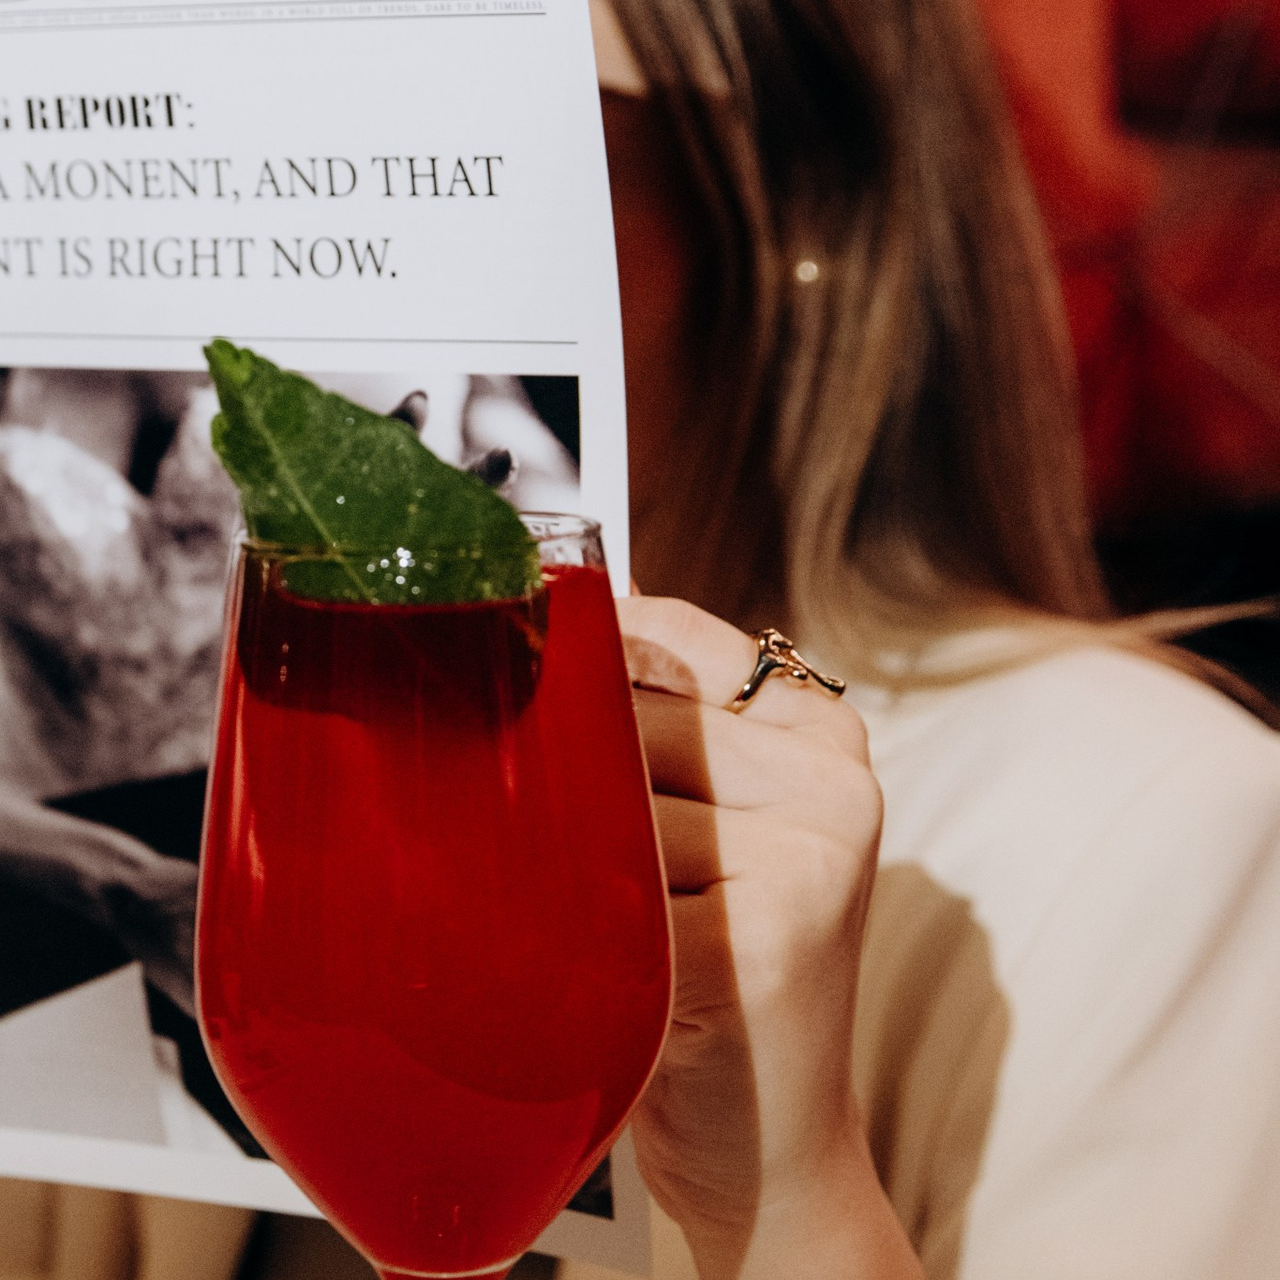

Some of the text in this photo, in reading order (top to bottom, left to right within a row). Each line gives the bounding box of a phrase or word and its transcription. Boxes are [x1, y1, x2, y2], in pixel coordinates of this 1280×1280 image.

[425, 2, 453, 12] DARE
[457, 2, 471, 11] TO
[476, 1, 488, 11] BE
[24, 92, 195, 133] REPORT:
[22, 156, 242, 205] MONENT,
[253, 156, 359, 200] AND
[370, 154, 505, 198] THAT
[57, 236, 95, 279] IS
[106, 236, 256, 280] RIGHT
[269, 236, 399, 280] NOW.
